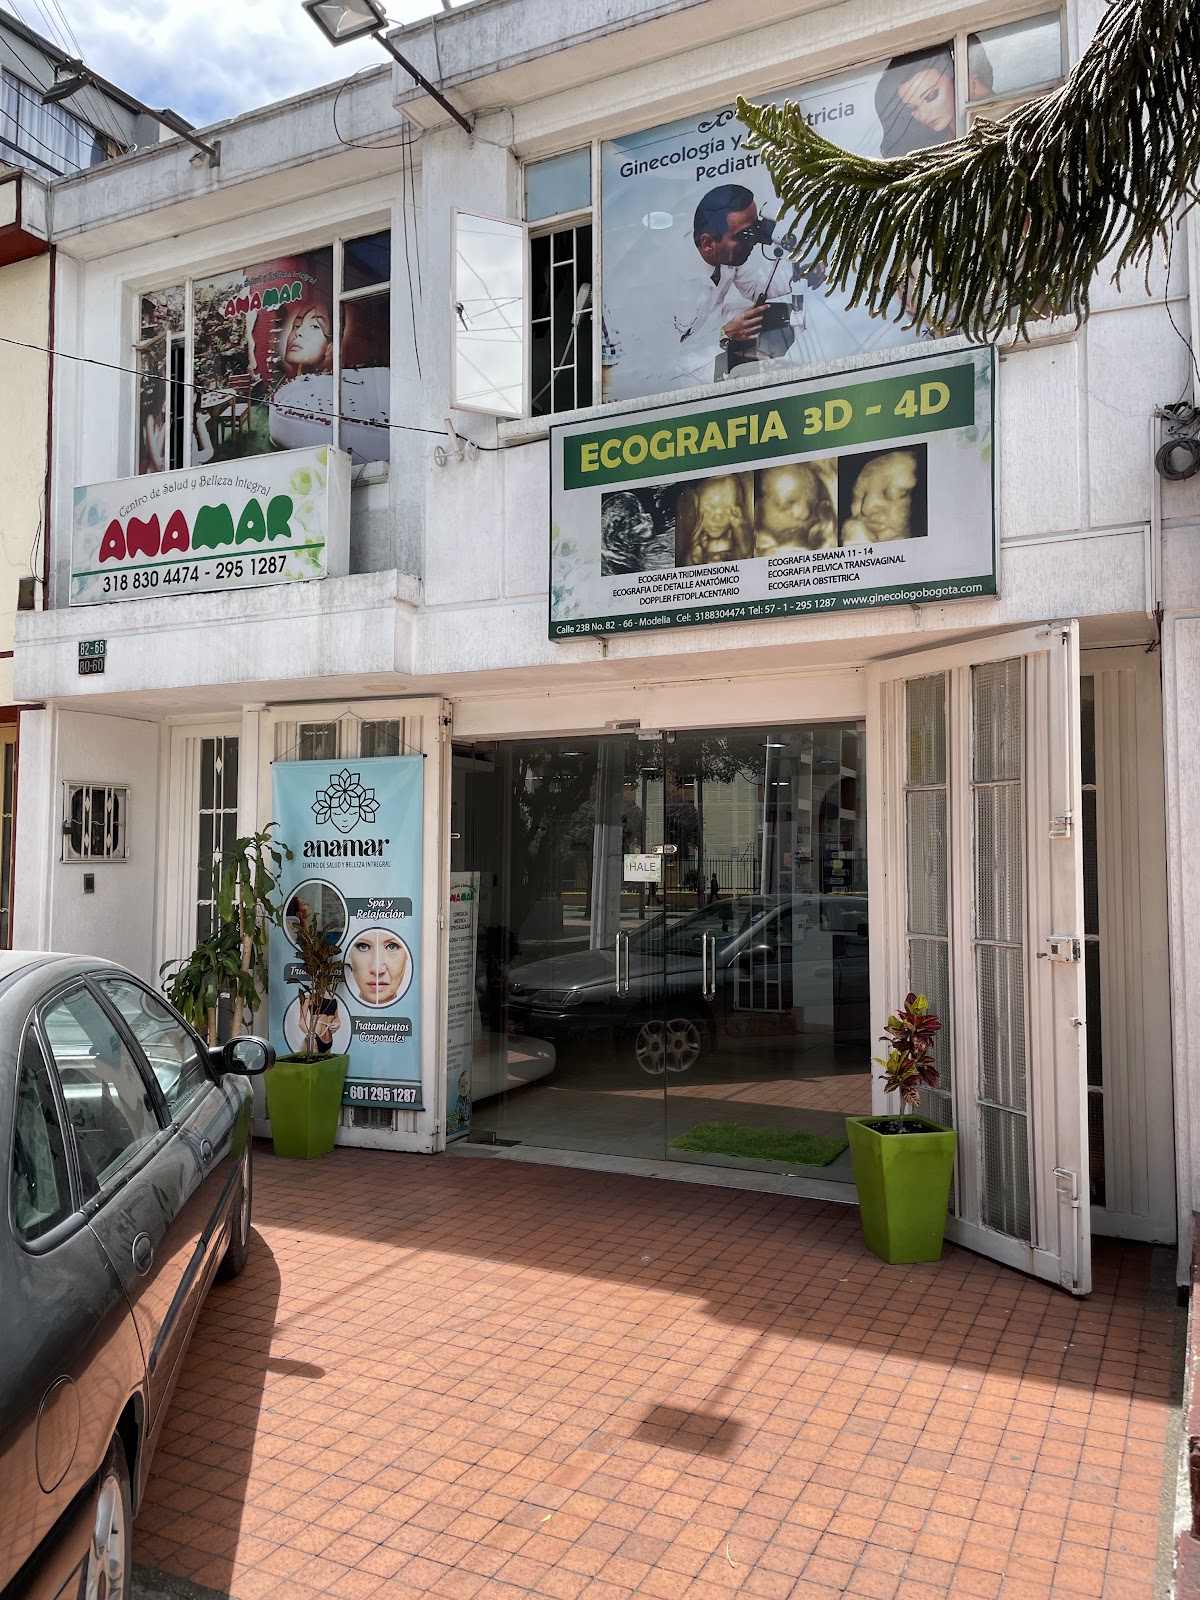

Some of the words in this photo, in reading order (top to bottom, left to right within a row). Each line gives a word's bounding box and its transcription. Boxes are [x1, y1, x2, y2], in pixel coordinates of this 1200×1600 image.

[620, 138, 726, 178] Ginecología
[731, 134, 742, 152] y
[224, 281, 303, 319] ANAMAR
[580, 409, 788, 473] ECOGRAFIA
[803, 399, 853, 435] 3D
[865, 404, 882, 416] -
[894, 381, 950, 419] 4D
[119, 495, 148, 517] Centro
[149, 489, 161, 500] de
[162, 478, 189, 494] Salud
[191, 479, 197, 490] y
[199, 475, 233, 488] Belleza
[235, 475, 272, 497] Integral
[98, 494, 294, 563] ANAMAR
[768, 554, 811, 567] ECOGRAFIA
[812, 550, 846, 562] SEMANA
[847, 549, 856, 558] 11
[863, 547, 874, 556] 14
[768, 566, 811, 578] ECOGRAFIA
[812, 562, 844, 574] PELVICA
[844, 555, 906, 570] TRANSVAGINAL
[103, 574, 128, 593] 318
[132, 571, 159, 589] 830
[162, 566, 199, 585] 4474
[215, 560, 243, 580] 295
[250, 554, 287, 576] 1287
[638, 571, 678, 584] ECOGRAFIA
[678, 564, 740, 579] TRIDIMENSIONAL
[768, 578, 811, 591] ECOGRAFIA
[812, 573, 860, 585] OBSTETRICA
[612, 585, 652, 597] ECOGRAFIA
[652, 584, 662, 592] DE
[663, 580, 694, 591] DETALLE
[694, 575, 740, 588] ANATÓMICO
[639, 595, 672, 605] DOPPLER
[672, 587, 740, 602] FETOPLACENTARIO
[556, 625, 574, 634] Calle
[576, 623, 590, 633] 23B
[591, 622, 604, 631] No.
[605, 621, 615, 630] 82
[623, 619, 633, 628] 66
[639, 616, 671, 627] Modelia
[676, 613, 692, 623] Cel:
[695, 607, 746, 621] 3188304474
[748, 605, 763, 615] Tel:
[764, 604, 776, 614] 57
[795, 600, 812, 610] 295
[814, 597, 836, 609] 1287
[842, 583, 983, 606] www.ginecologobogota.com
[80, 641, 104, 656] 82-66
[80, 658, 104, 673] 80-60
[303, 838, 390, 858] anamar
[302, 861, 320, 869] CENTRO
[320, 861, 326, 869] DE
[629, 862, 656, 872] HALE
[367, 897, 385, 909] Spa
[386, 899, 394, 909] y
[356, 909, 405, 920] Relajación
[355, 1020, 410, 1031] Tratamientos
[359, 1031, 405, 1044] Corporales
[349, 1085, 369, 1100] 601
[370, 1086, 391, 1102] 295
[392, 1087, 417, 1103] 1287
